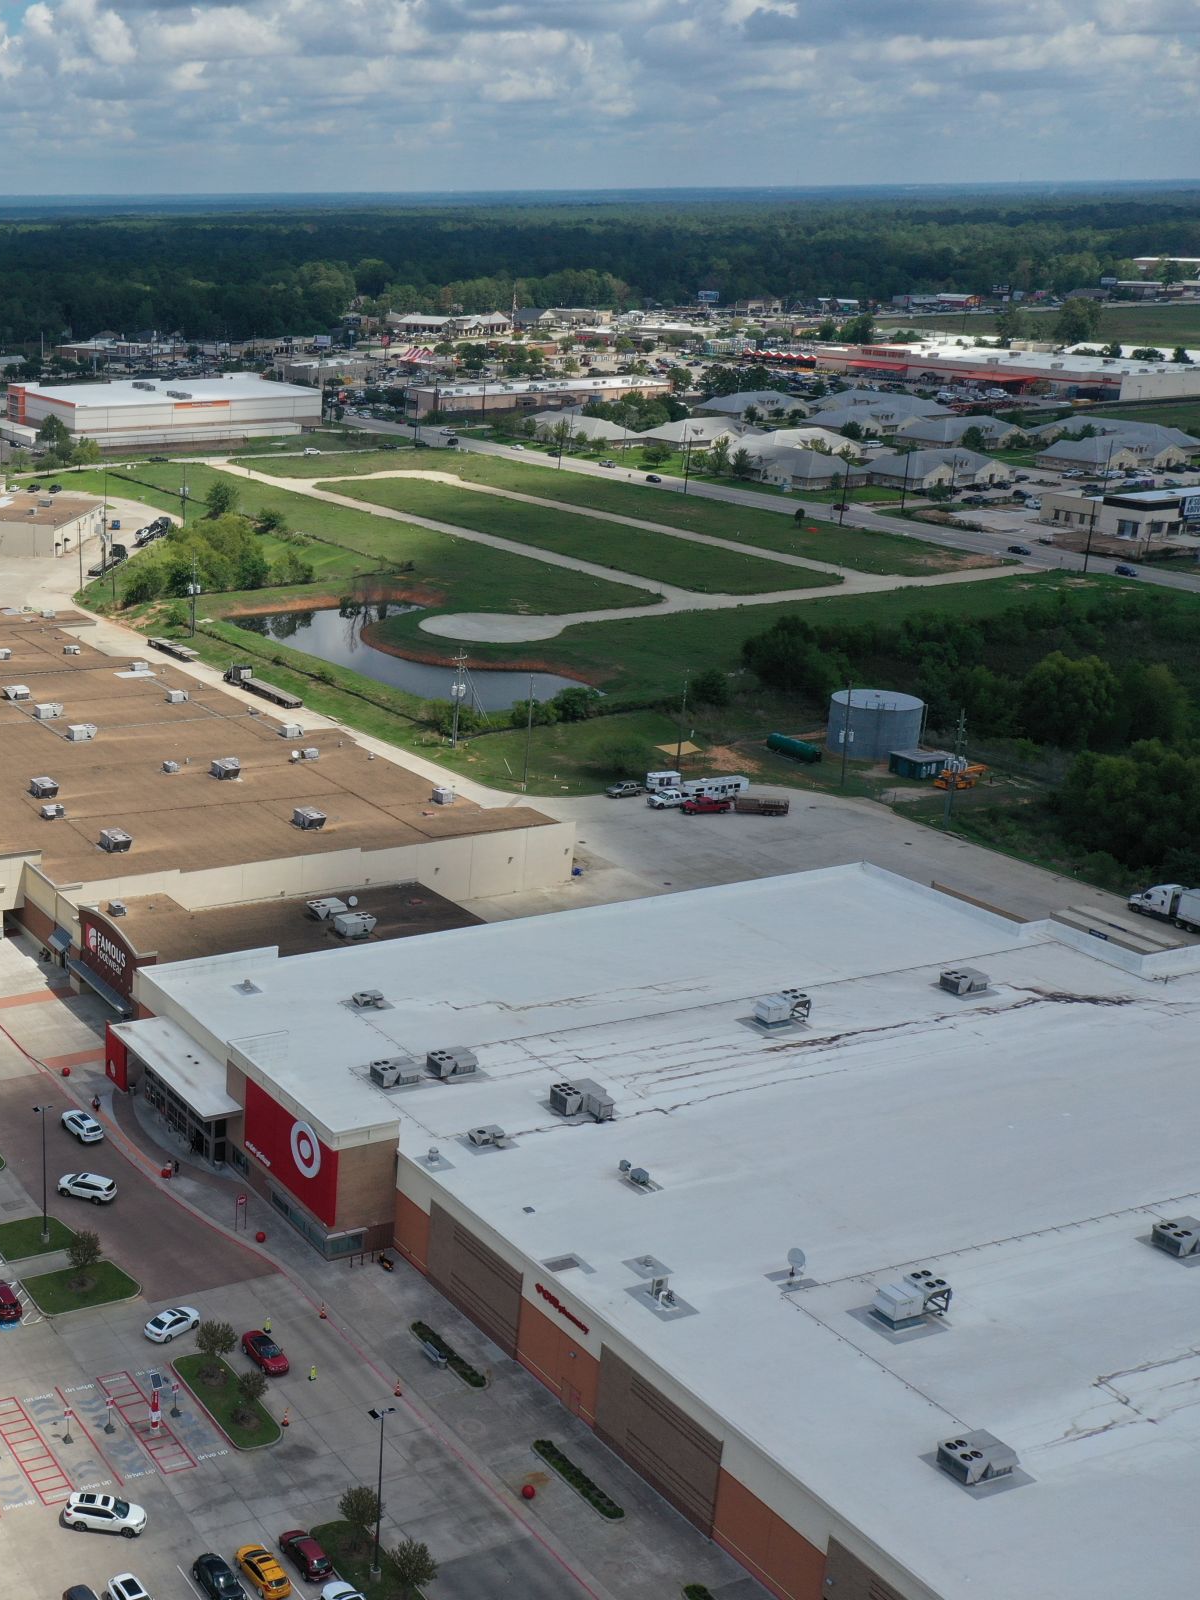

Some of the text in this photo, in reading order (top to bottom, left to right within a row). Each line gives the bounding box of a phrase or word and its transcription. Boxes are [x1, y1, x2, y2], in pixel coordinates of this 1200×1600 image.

[97, 931, 127, 968] FAMOUS
[97, 946, 123, 976] footwear
[101, 1479, 113, 1487] up
[23, 1499, 36, 1507] up
